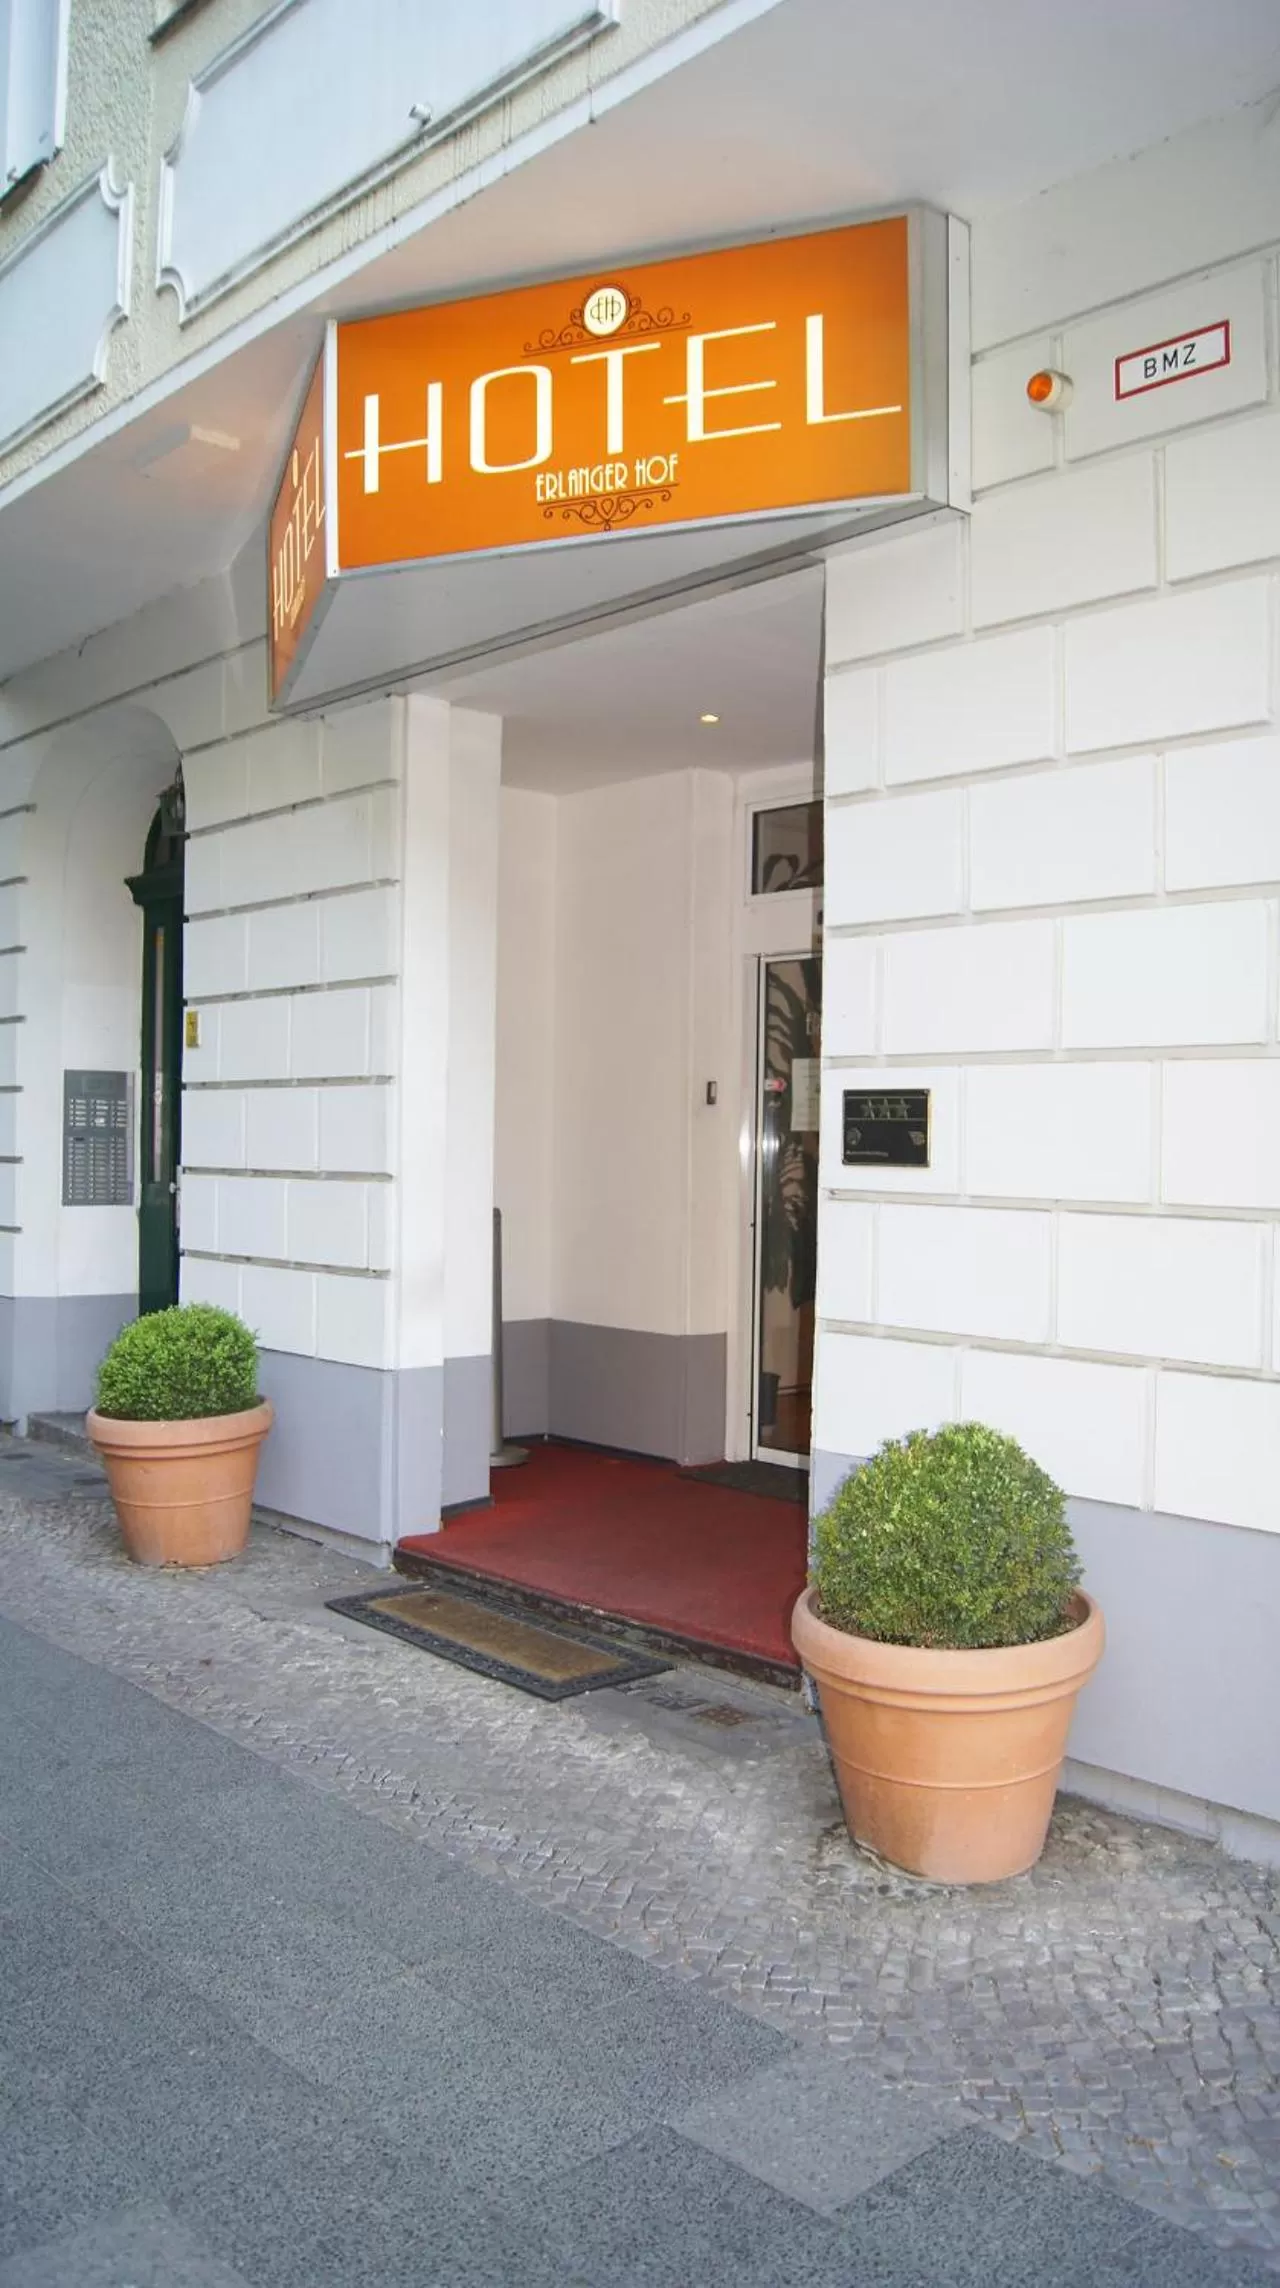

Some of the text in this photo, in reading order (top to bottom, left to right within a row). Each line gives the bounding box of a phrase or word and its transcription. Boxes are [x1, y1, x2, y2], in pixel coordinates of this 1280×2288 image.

[344, 314, 902, 495] HOTEL
[1143, 342, 1196, 379] BMZ
[535, 452, 679, 502] ERLANGER HOF
[272, 436, 326, 641] HOTEL
